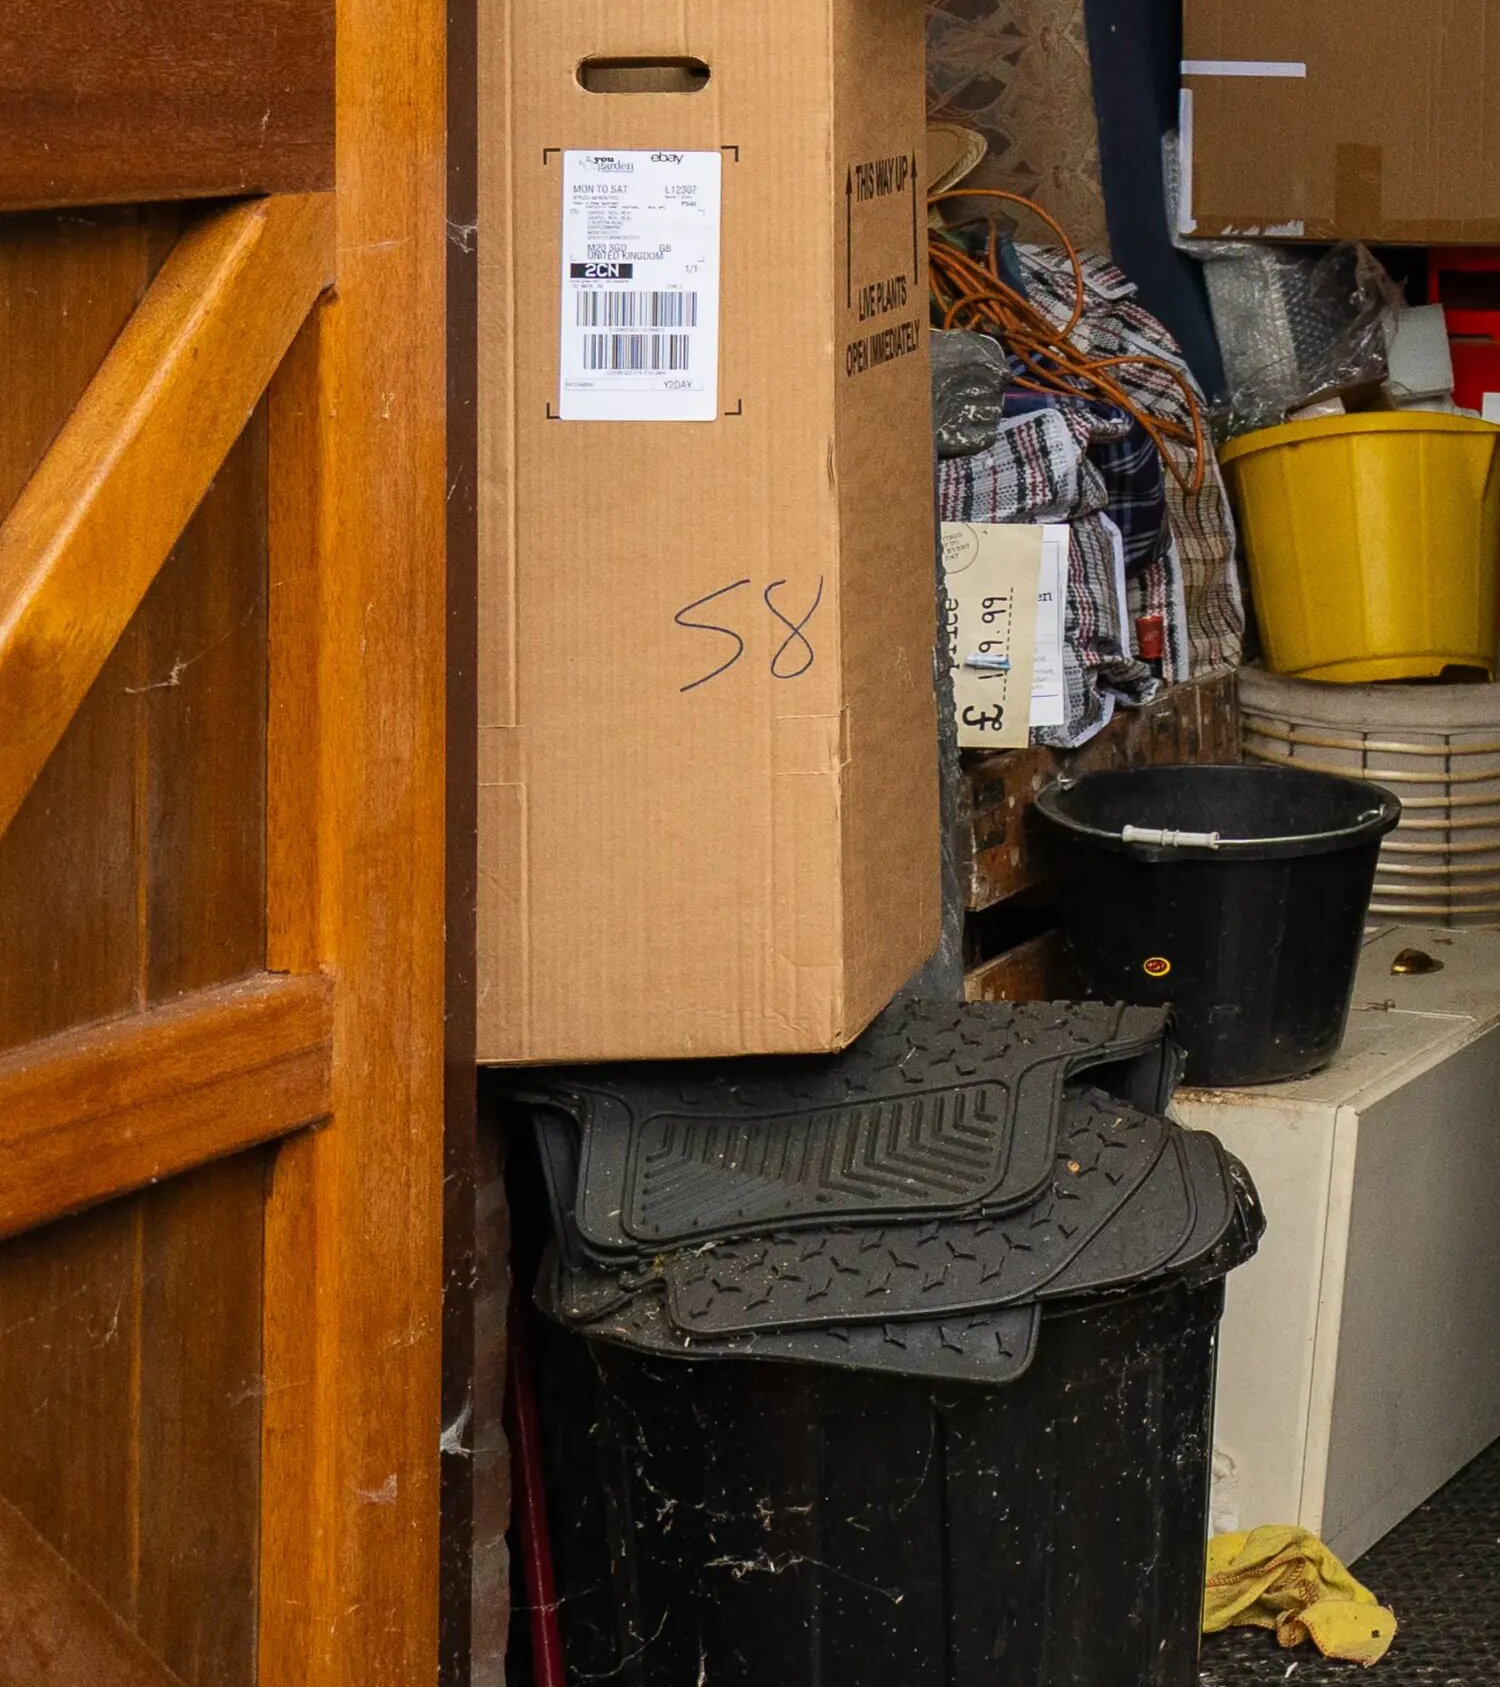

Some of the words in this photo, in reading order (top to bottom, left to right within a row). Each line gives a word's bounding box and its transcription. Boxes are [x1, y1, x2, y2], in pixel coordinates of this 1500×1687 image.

[594, 156, 614, 164] you
[651, 152, 684, 164] ebay
[856, 163, 874, 202] THIS
[876, 158, 894, 196] WAY
[896, 155, 908, 191] UP
[573, 185, 594, 193] MON
[597, 185, 608, 193] TO
[611, 185, 628, 193] SAT
[587, 252, 619, 260] UNITED
[622, 252, 664, 260] KINGDOM
[585, 264, 619, 277] 2CN
[858, 284, 875, 321] LIVE
[877, 274, 907, 315] PLANTS
[846, 338, 868, 377] OPEN
[870, 319, 920, 367] IMMEDIATELY
